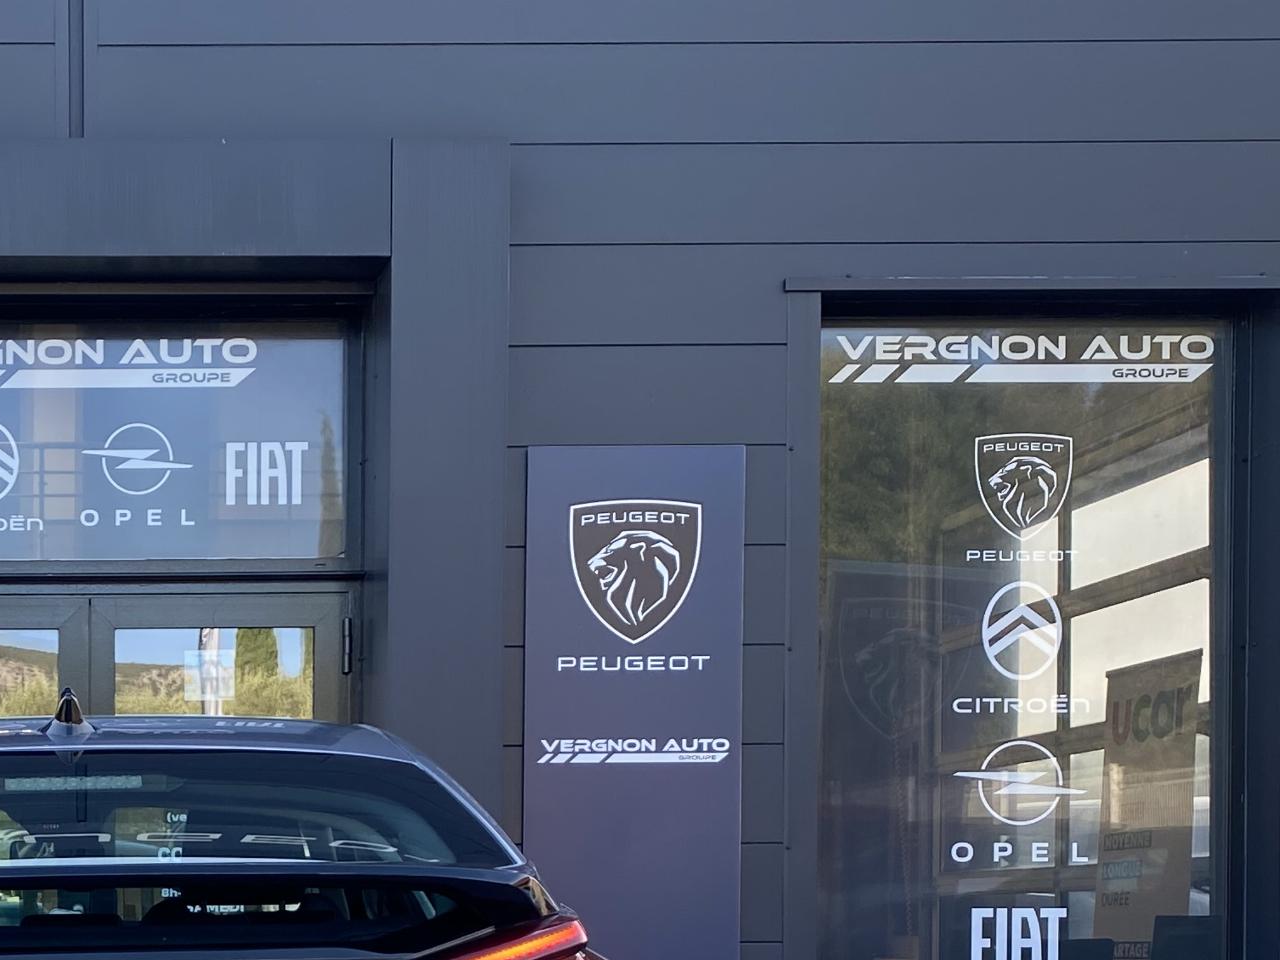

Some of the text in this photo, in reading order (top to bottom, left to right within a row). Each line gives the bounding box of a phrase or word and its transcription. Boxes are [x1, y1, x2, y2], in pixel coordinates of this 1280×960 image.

[118, 337, 258, 366] AUTO
[836, 334, 1215, 360] VERGNON AUTO
[151, 373, 231, 383] GROUPE
[1111, 368, 1190, 378] GROUPE
[982, 442, 1065, 453] PEUGEOT
[225, 441, 309, 505] FIAT
[79, 508, 195, 527] OPEL
[580, 511, 690, 526] PEUGEOT
[966, 550, 1078, 562] PEUGEOT
[557, 655, 711, 671] PEUGEOT
[541, 738, 730, 752] VERGNON AUTO
[951, 842, 1089, 862] OPEL
